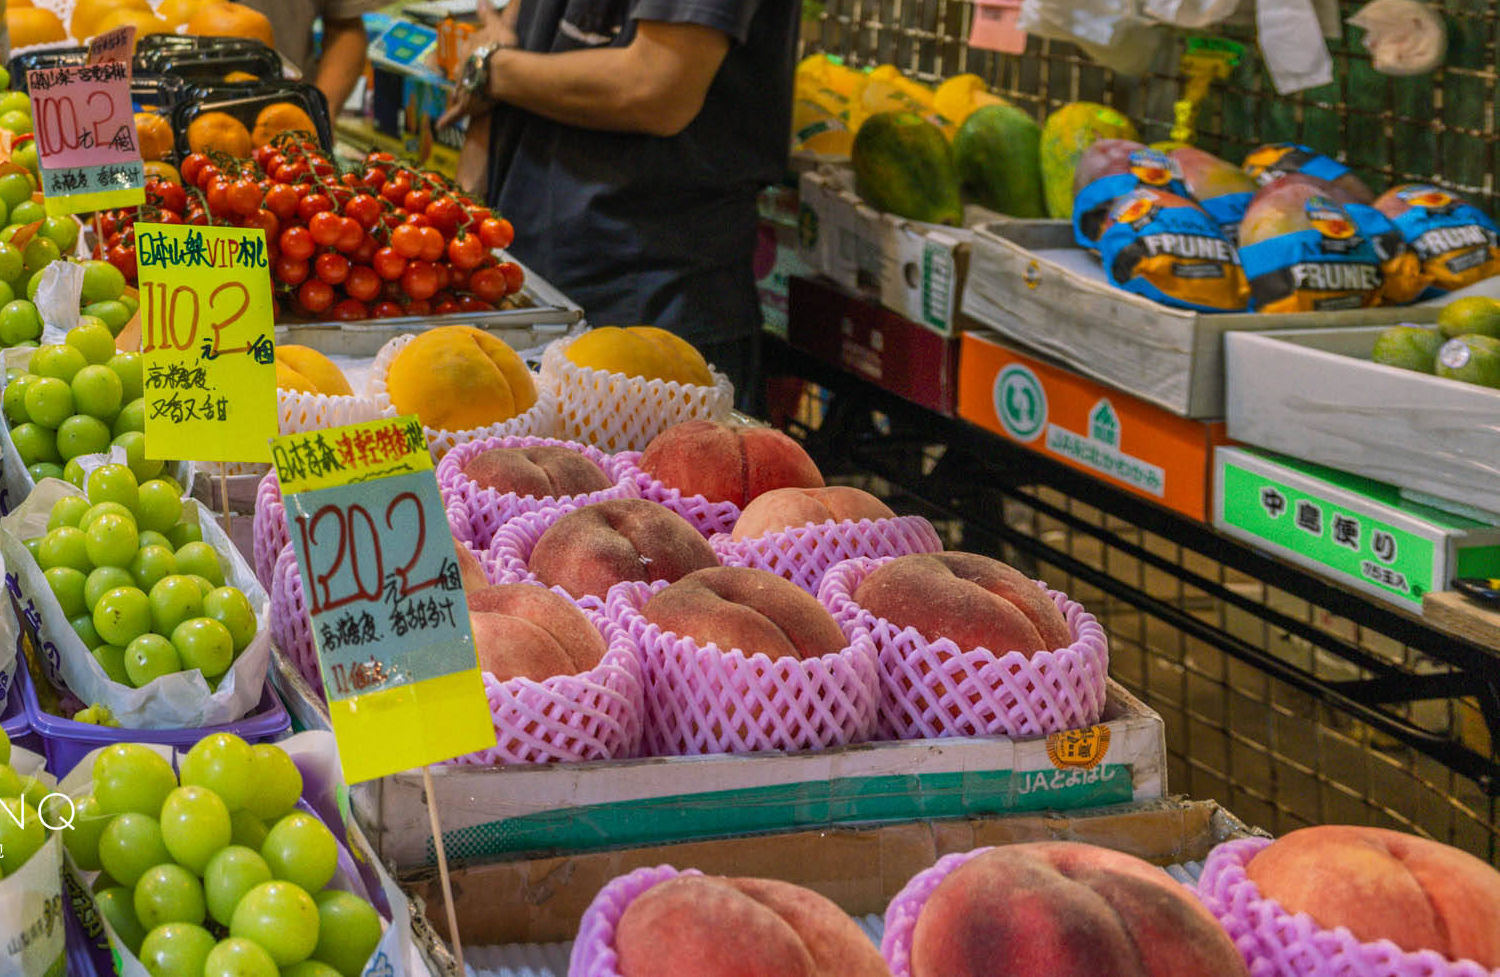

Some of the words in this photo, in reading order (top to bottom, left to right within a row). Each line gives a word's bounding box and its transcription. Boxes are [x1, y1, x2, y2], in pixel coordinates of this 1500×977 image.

[33, 95, 82, 158] 100
[86, 90, 117, 149] 2
[142, 280, 200, 354] 110
[208, 280, 252, 356] 2
[295, 502, 385, 617] 120
[385, 491, 442, 596] 2
[1259, 486, 1398, 563] 中島便り
